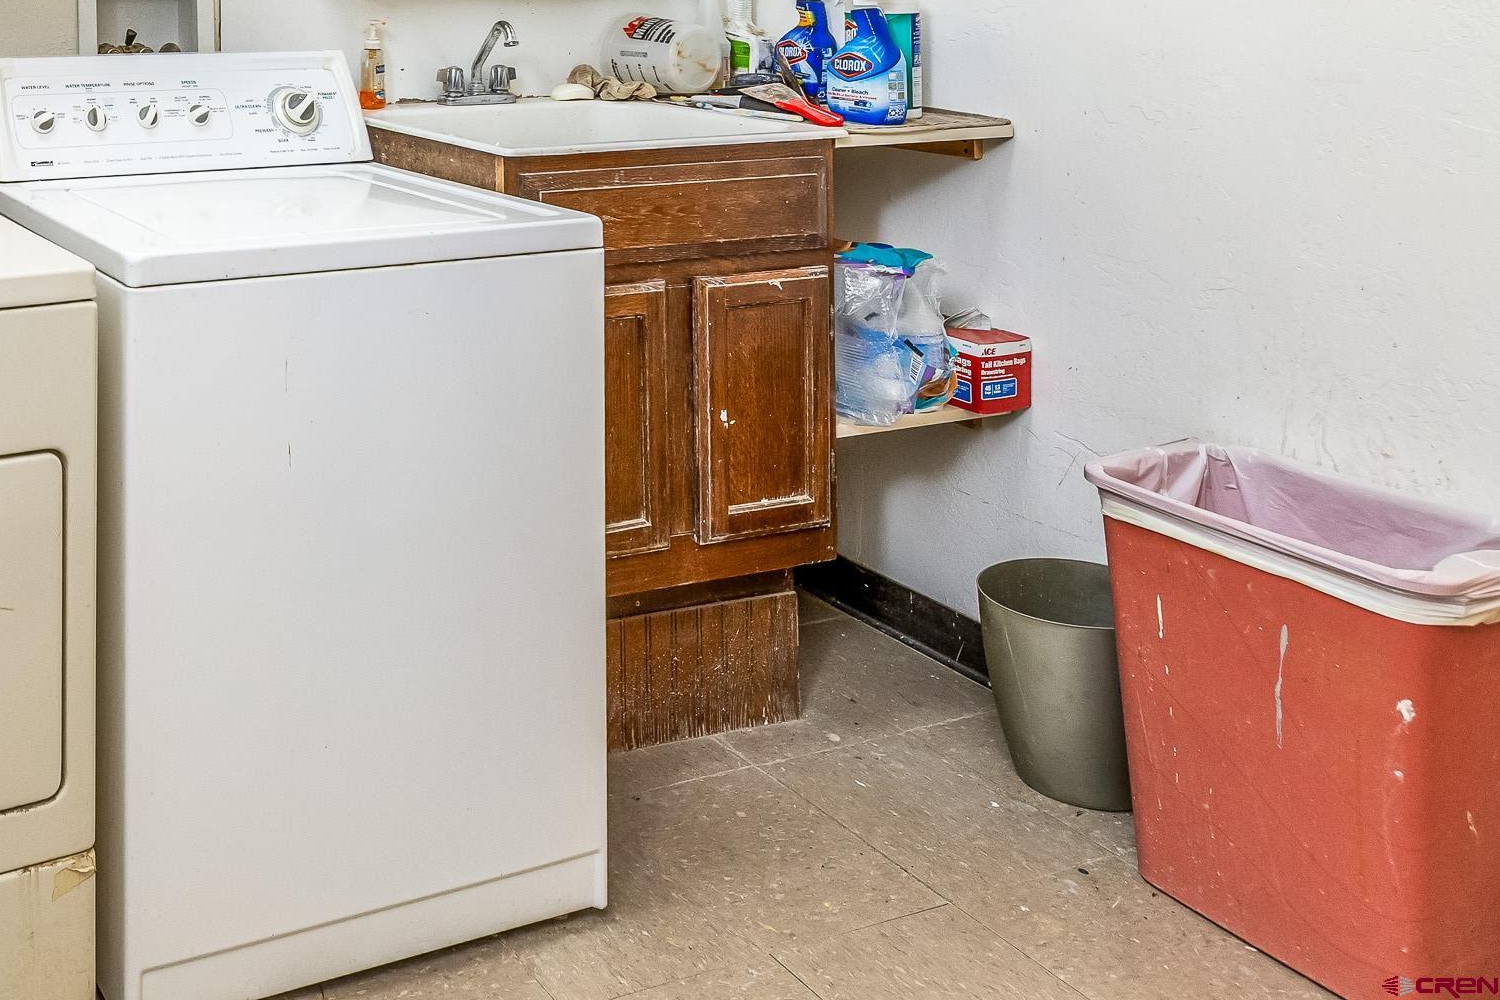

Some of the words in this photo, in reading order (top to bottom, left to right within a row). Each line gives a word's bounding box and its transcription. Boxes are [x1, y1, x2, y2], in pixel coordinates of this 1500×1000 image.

[834, 58, 866, 72] CLOROX
[981, 347, 996, 356] ACE
[981, 361, 992, 369] Tall
[994, 359, 1013, 368] Kitchen
[1014, 357, 1026, 365] Bags
